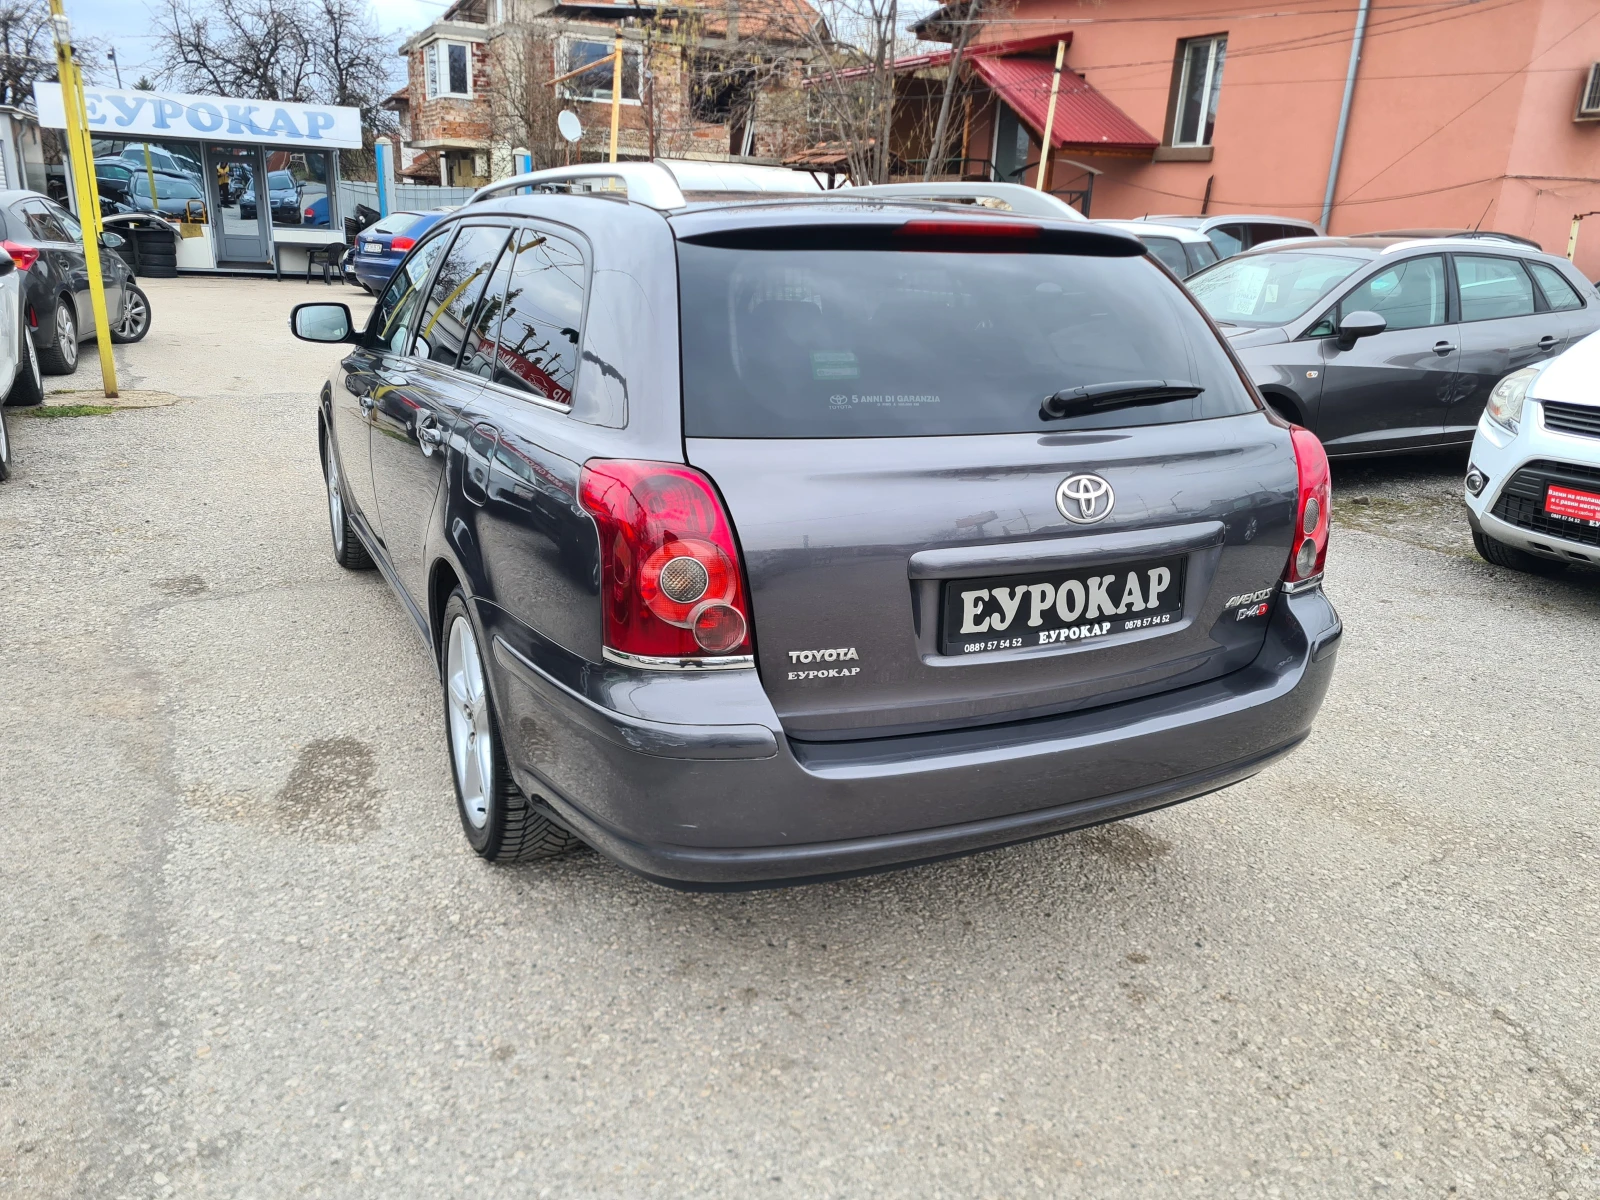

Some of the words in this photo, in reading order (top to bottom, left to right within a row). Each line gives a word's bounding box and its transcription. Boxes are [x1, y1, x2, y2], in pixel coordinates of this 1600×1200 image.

[85, 93, 335, 140] ЕУРОКАР
[852, 394, 859, 403] 5
[861, 395, 883, 403] ANNI
[896, 395, 940, 403] GARANZIA
[960, 566, 1171, 634] ЕУРОКАР
[1124, 619, 1142, 629] 0878
[1142, 617, 1151, 626] 57
[1152, 615, 1161, 624] 54
[1162, 614, 1170, 623] 52
[1038, 622, 1111, 644] ЕУРОКАР
[964, 642, 985, 653] 0889
[987, 640, 998, 650] 57
[1000, 639, 1010, 649] 54
[1012, 637, 1022, 647] 52
[788, 647, 860, 664] TOYOTA
[787, 667, 861, 681] ЕУРОКАР
